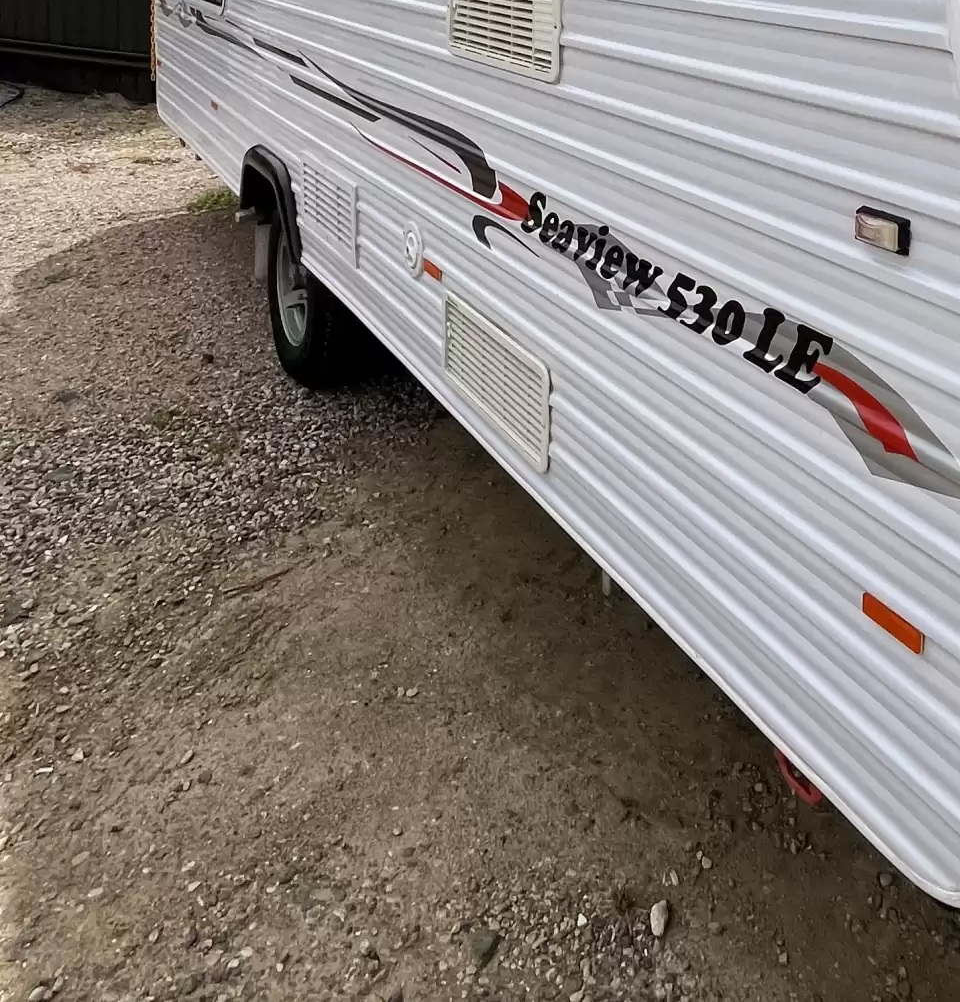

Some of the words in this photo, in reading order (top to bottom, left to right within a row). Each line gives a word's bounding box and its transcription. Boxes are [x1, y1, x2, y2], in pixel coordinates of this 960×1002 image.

[520, 191, 664, 297] Seaview
[657, 272, 746, 345] 530
[743, 307, 834, 394] LE
